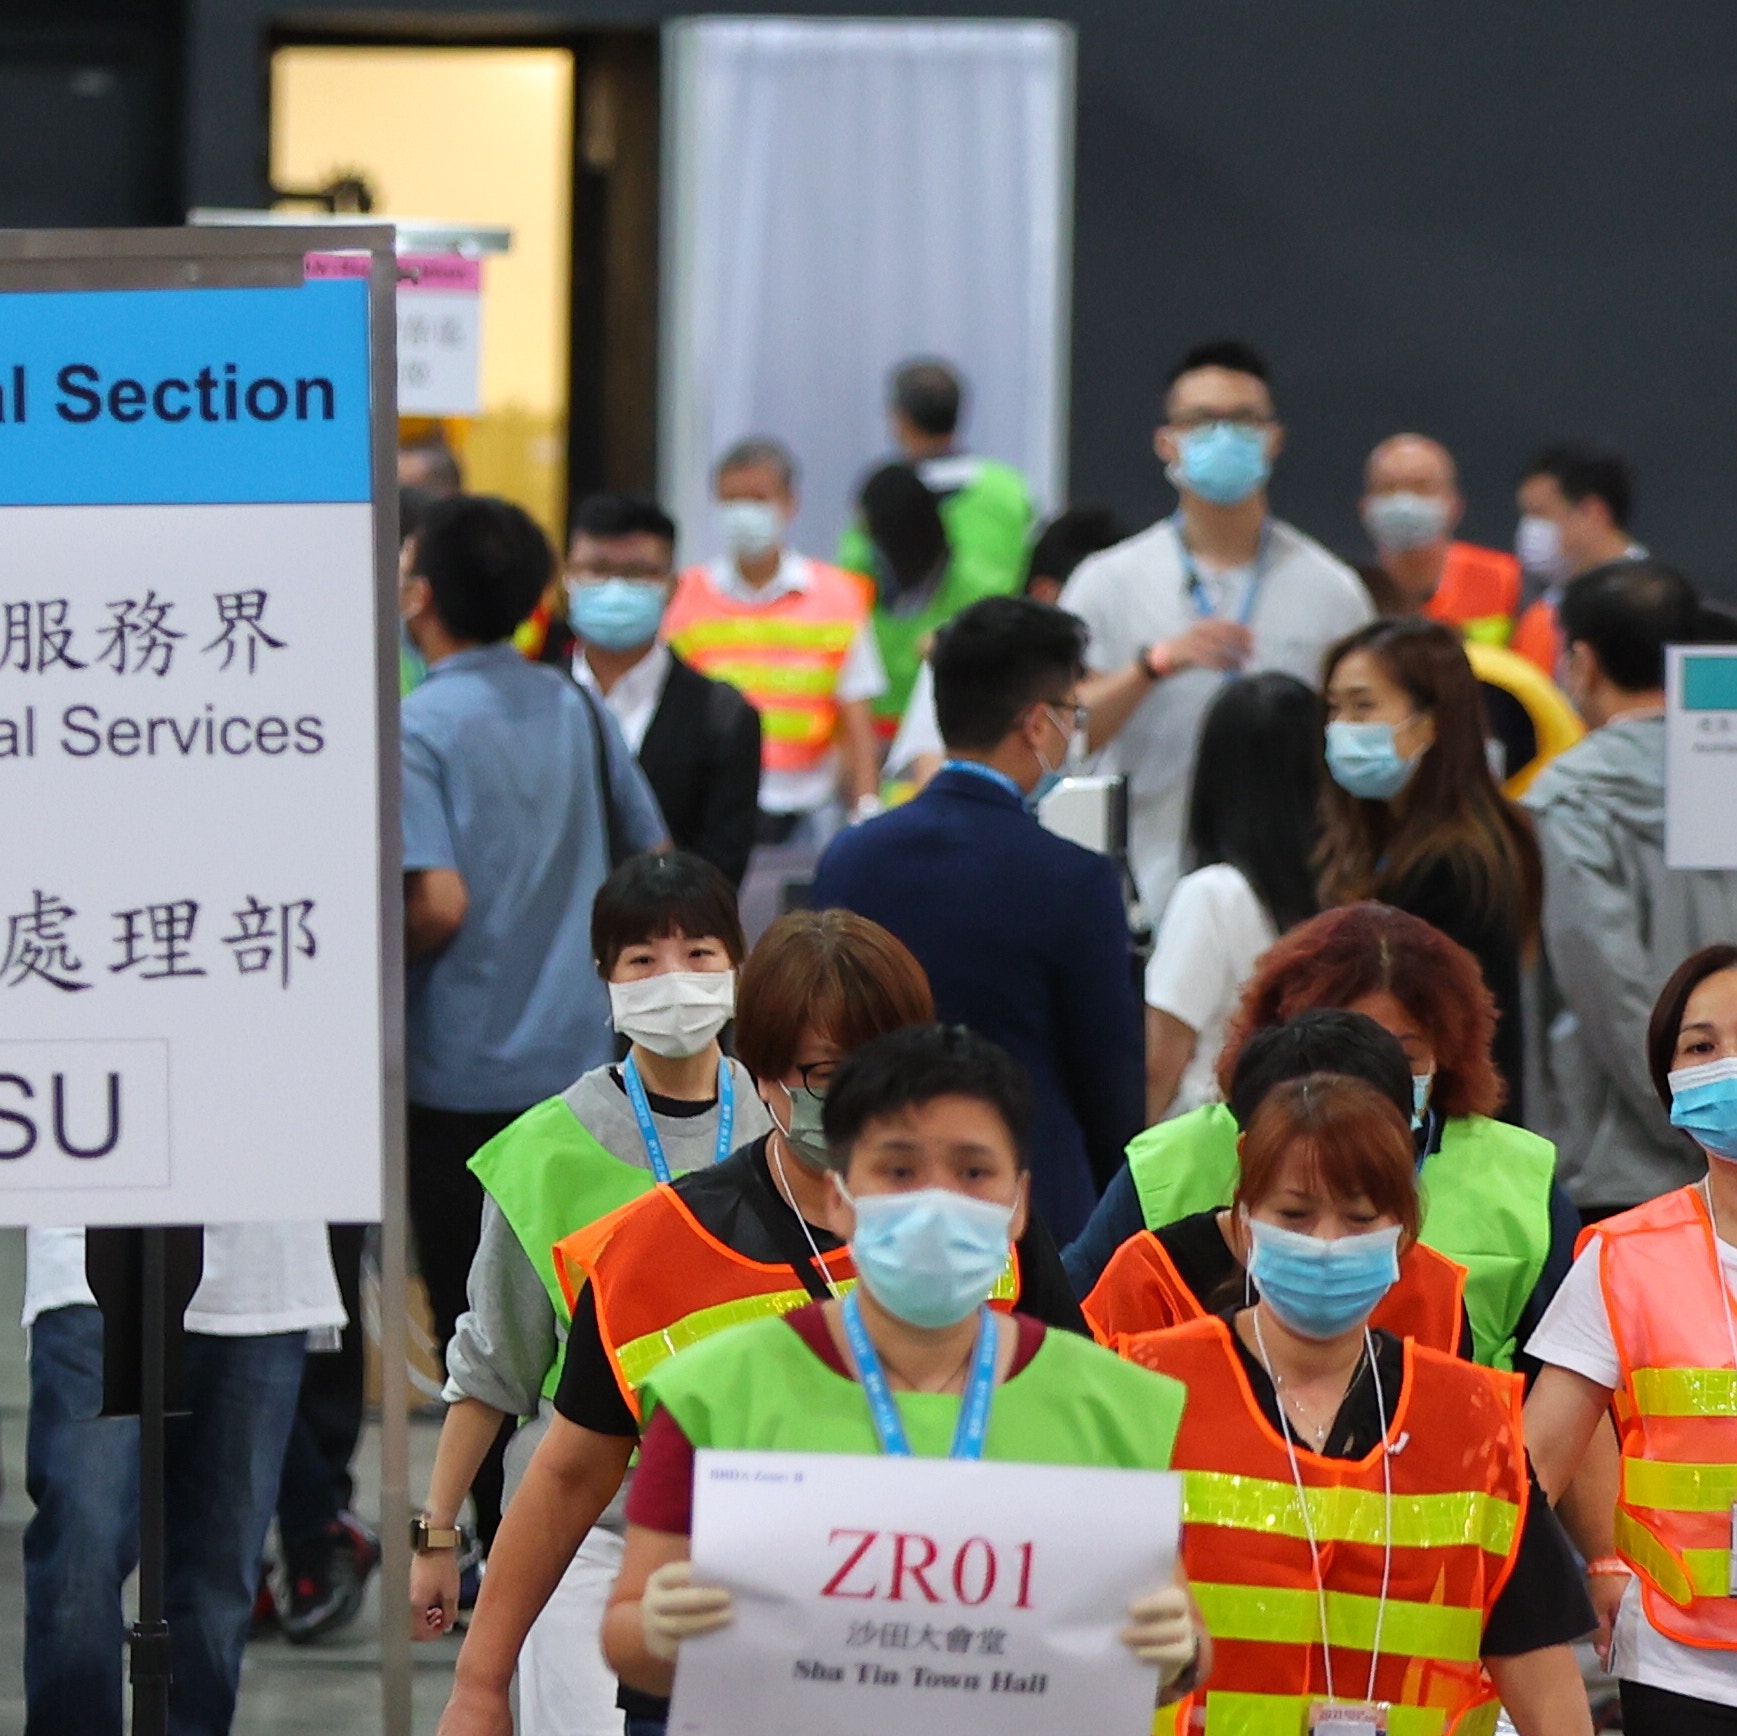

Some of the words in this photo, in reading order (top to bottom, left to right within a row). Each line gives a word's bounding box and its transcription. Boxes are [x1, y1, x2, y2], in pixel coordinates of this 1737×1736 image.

[54, 362, 336, 424] Section
[59, 704, 325, 758] Services
[819, 1528, 1036, 1610] ZR01
[845, 1619, 1009, 1656] 沙田大會堂
[793, 1659, 845, 1684] Sha
[855, 1662, 901, 1687] Tin
[912, 1666, 982, 1692] Town
[990, 1670, 1049, 1696] Hall
